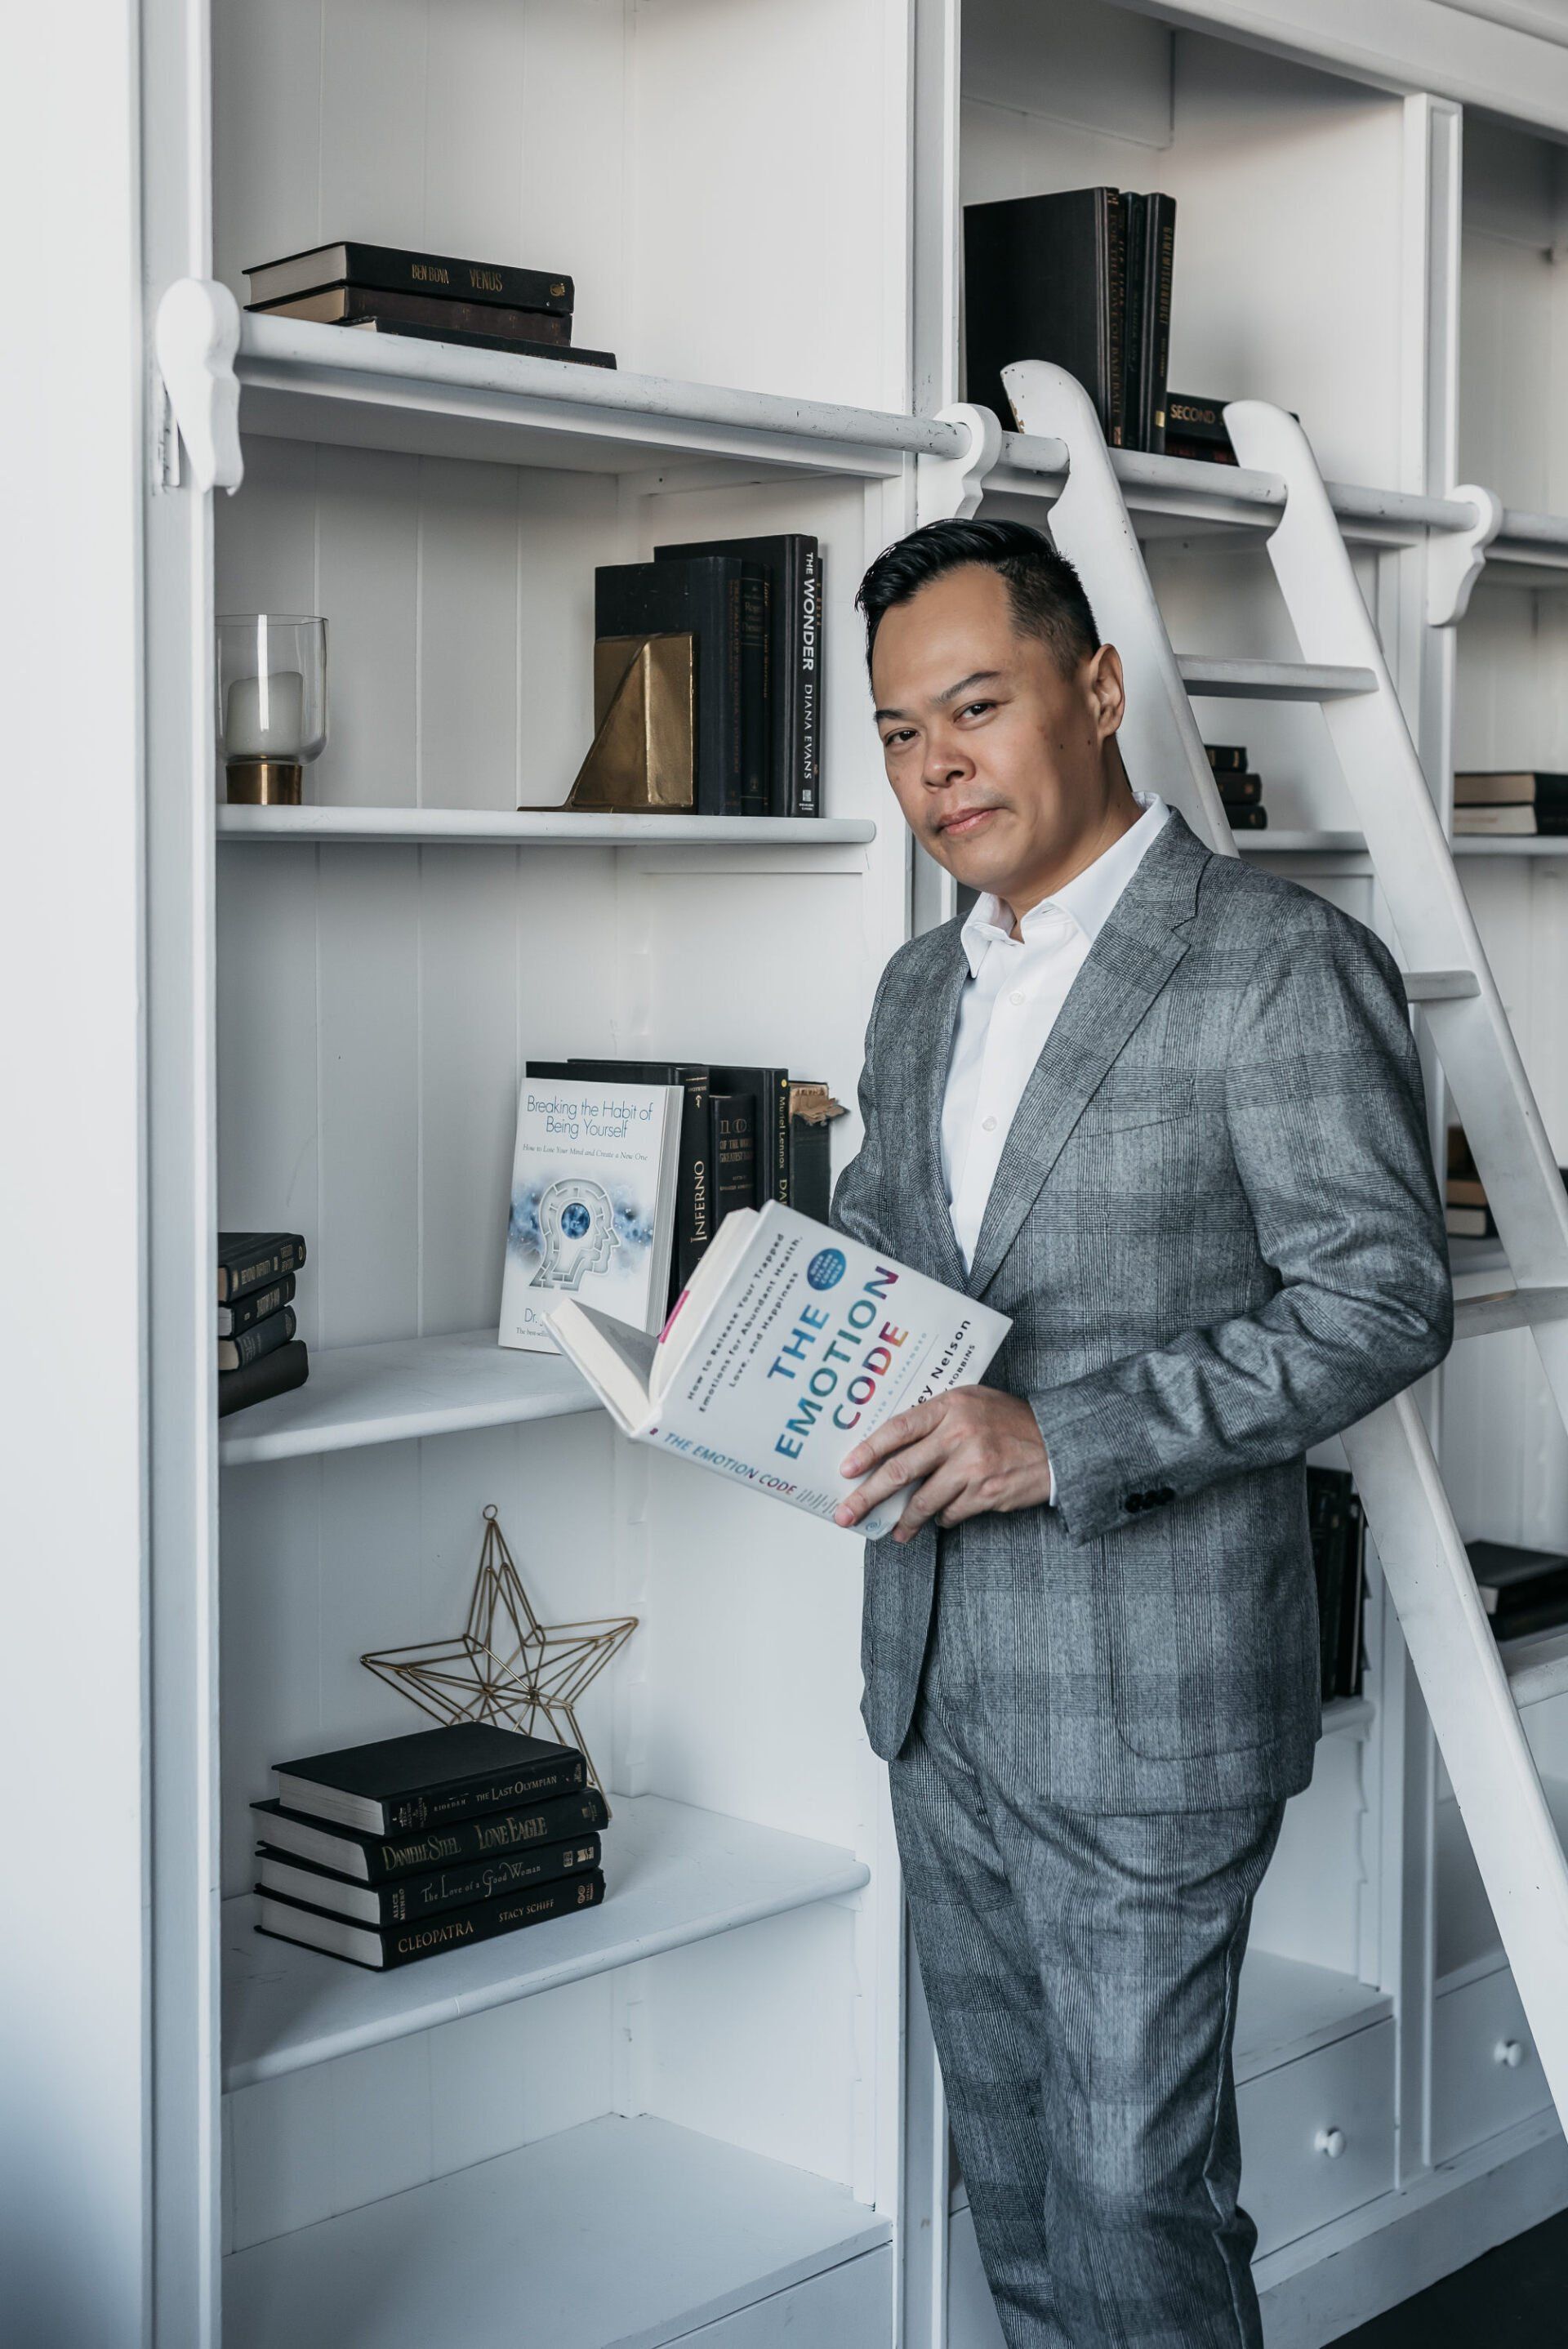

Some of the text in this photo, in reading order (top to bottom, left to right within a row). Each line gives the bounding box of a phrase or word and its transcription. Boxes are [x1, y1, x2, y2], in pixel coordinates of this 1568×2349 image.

[412, 264, 427, 280] BEN
[470, 268, 503, 292] VENUS
[803, 578, 815, 671] WONDER
[804, 684, 813, 780] DIANA EVANS
[528, 1095, 653, 1121] Breaking the Habit of
[546, 1116, 629, 1139] Being Yourself
[523, 1143, 535, 1152] How
[621, 1152, 633, 1160] New
[778, 1096, 786, 1169] Muriel Lennox
[689, 1160, 708, 1243] INFERNO
[524, 1308, 538, 1324] Dr.
[688, 1234, 784, 1399] How to Release Your Trapped
[699, 1235, 804, 1412] Emotions for Abundant Health,
[729, 1273, 798, 1387] Love, and Happiness
[767, 1304, 831, 1384] THE
[774, 1265, 899, 1460] EMOTION
[931, 1321, 970, 1379] Nelson
[949, 1345, 974, 1385] ROBBINS
[832, 1321, 910, 1431] CODE
[664, 1432, 798, 1495] THE EMOTION CODE
[476, 1776, 557, 1802] THE LAST OLYMPIAN
[382, 1834, 462, 1870] DANIELLE STEEL
[474, 1816, 548, 1850] LONE EAGLE
[420, 1883, 439, 1903] The
[441, 1874, 462, 1898] Love
[466, 1882, 474, 1891] of
[482, 1869, 507, 1898] Good
[499, 1861, 541, 1881] Woman
[499, 1899, 555, 1923] STACY SCHIFF
[398, 1920, 474, 1953] CLEOPATRA
